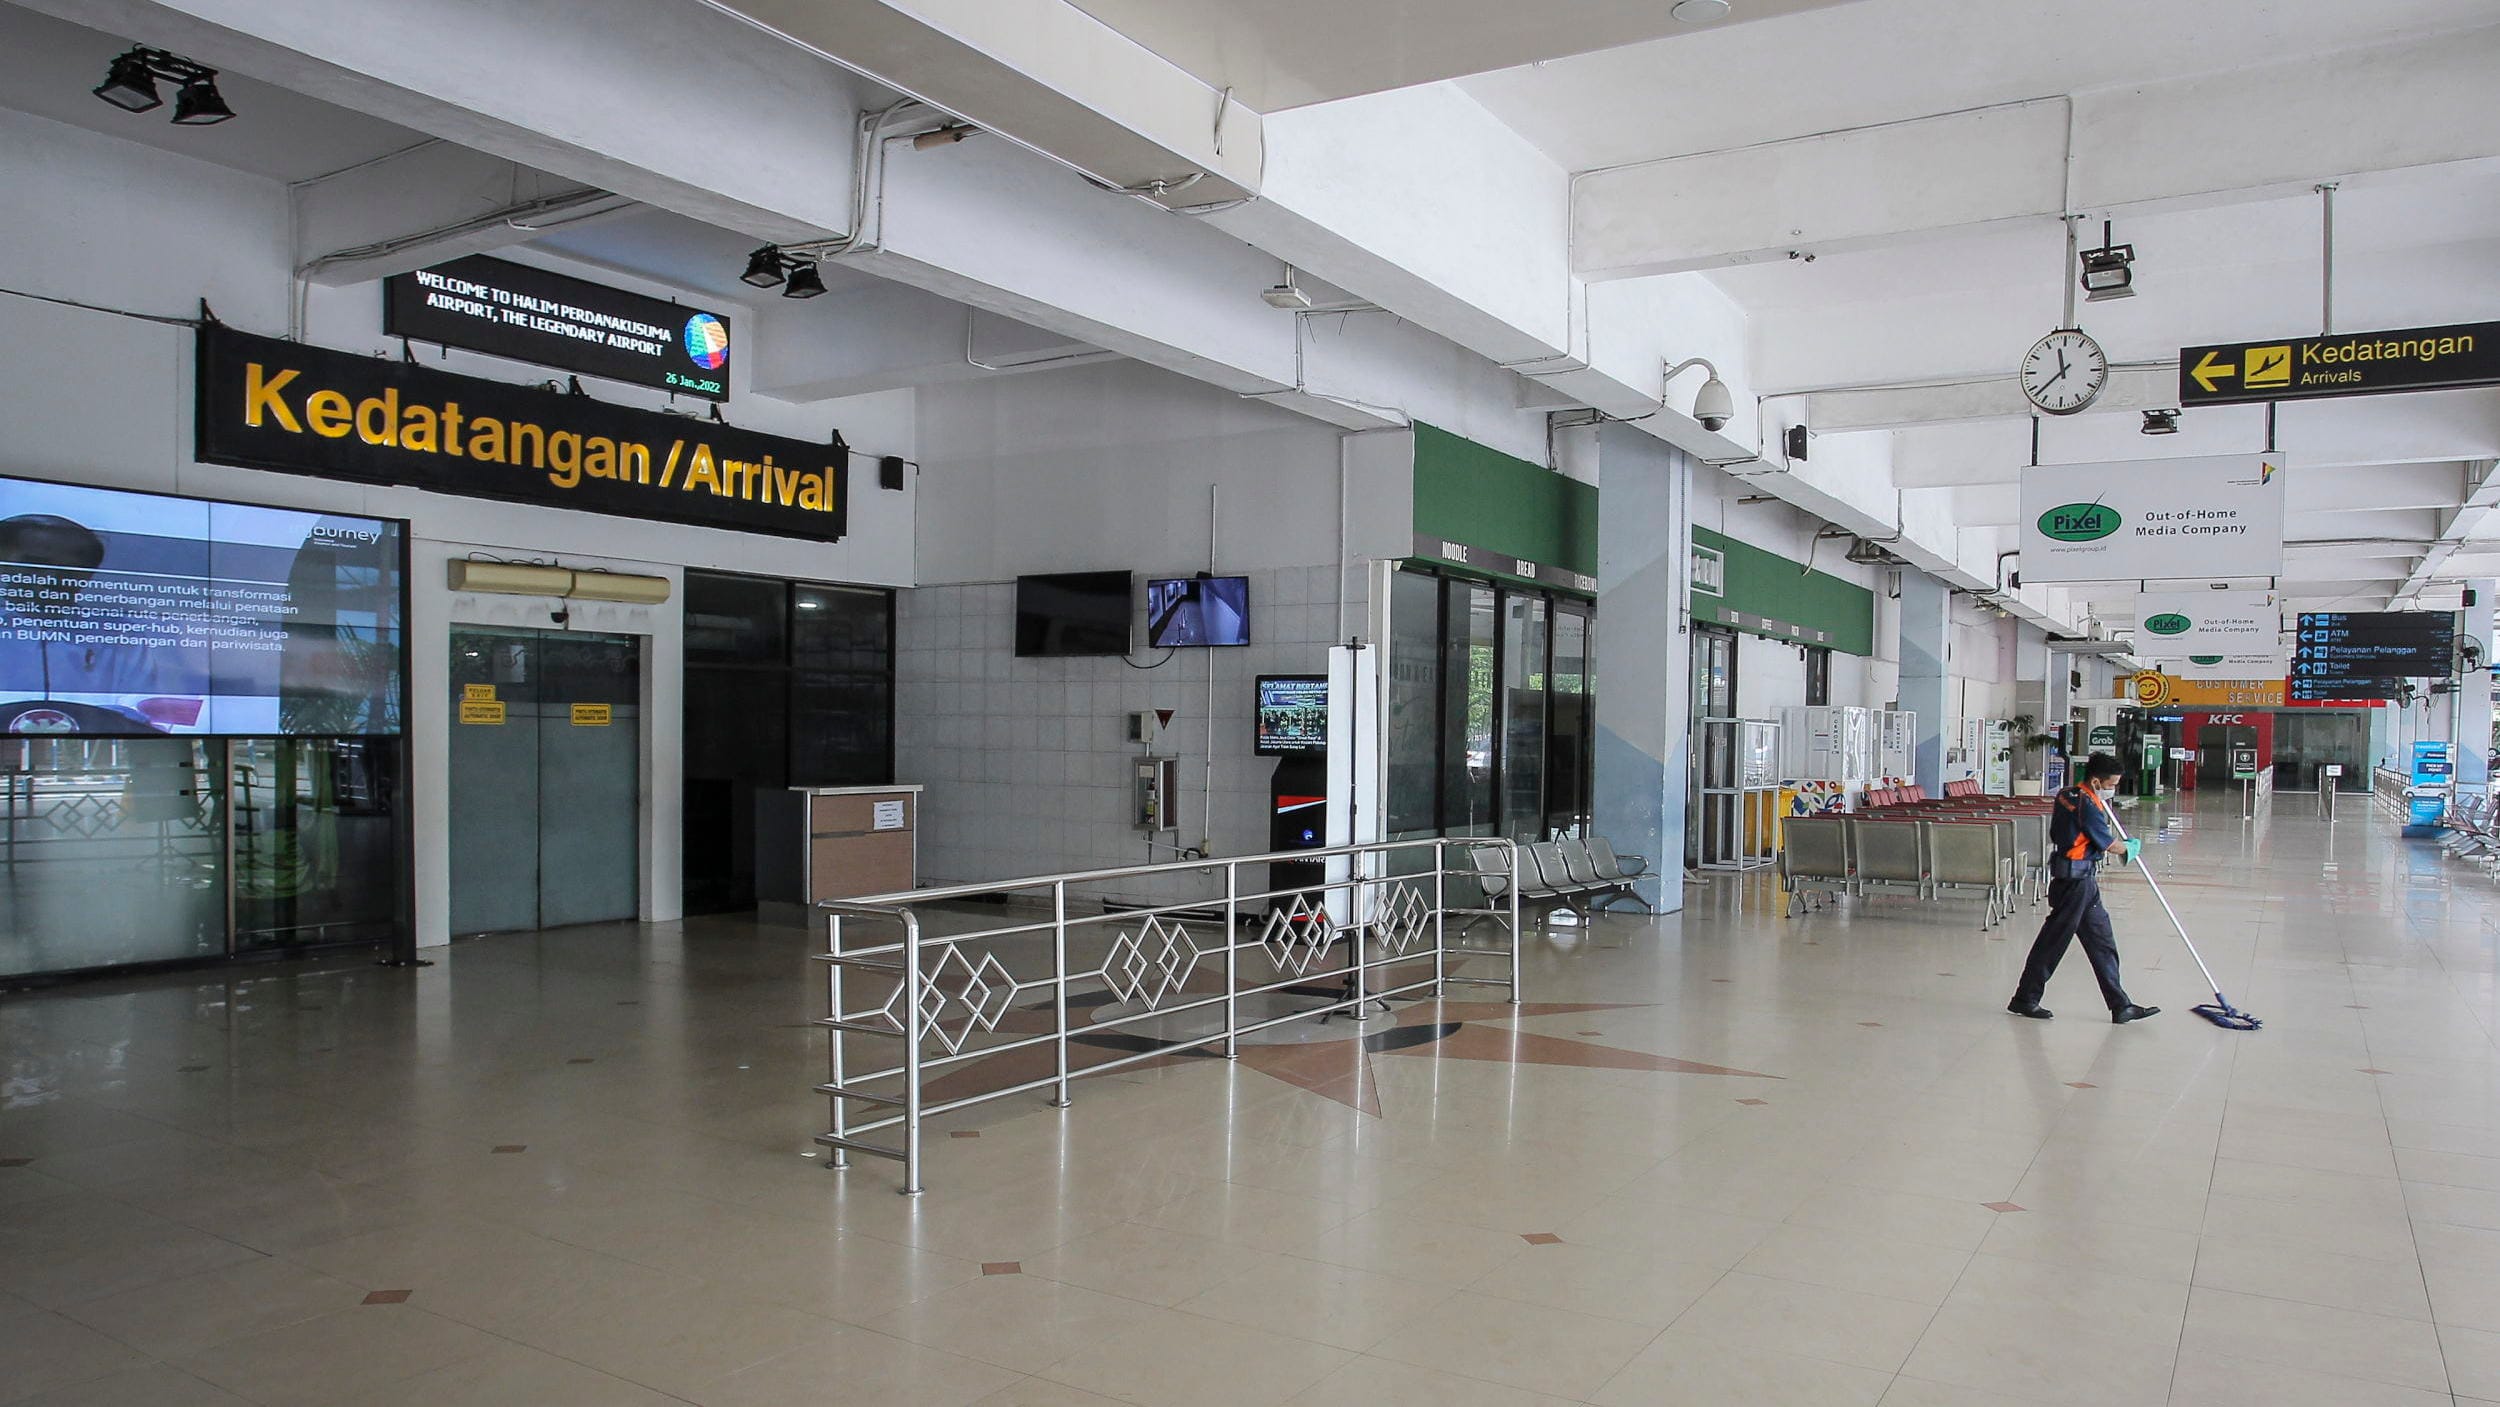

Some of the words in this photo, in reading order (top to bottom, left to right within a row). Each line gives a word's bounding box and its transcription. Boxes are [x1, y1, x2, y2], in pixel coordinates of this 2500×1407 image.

[416, 270, 489, 300] WELCOME
[490, 287, 511, 305] TO
[512, 293, 559, 316] HALIM
[560, 304, 672, 343] PERDANAKUSUMA
[426, 292, 498, 323] AIRPORT,
[501, 308, 529, 327] THE
[529, 315, 605, 344] LEGENDARY
[607, 333, 663, 357] AIRPORT
[2302, 335, 2473, 366] Kedatangan
[665, 372, 678, 385] 26
[2301, 369, 2362, 385] Arrivals
[245, 362, 651, 489] Kedatangan
[682, 442, 834, 513] Arrival
[2054, 505, 2101, 532] Pixel
[2145, 508, 2237, 521] Out-of-Home
[2135, 525, 2177, 536] Media
[2182, 525, 2247, 537] Company
[1442, 540, 1468, 563] NOODLE
[1516, 559, 1536, 579] BREAD
[0, 573, 57, 586] adalah
[61, 577, 154, 593] momentum
[157, 584, 199, 597] untuk
[203, 587, 291, 602] transformasi
[39, 589, 69, 600] dan
[74, 591, 175, 608] penerbangan
[179, 599, 231, 611] melalui
[235, 602, 298, 615] penataan
[5, 600, 41, 613] baik
[44, 604, 123, 619] mengenai
[128, 609, 158, 620] rute
[161, 611, 259, 626] penerbangan,
[2153, 615, 2180, 628] Pixel
[12, 616, 99, 630] penentuan
[103, 620, 183, 636] super-hub,
[187, 625, 256, 638] kemudian
[259, 630, 288, 641] juga
[17, 629, 71, 642] BUMN
[75, 633, 176, 649] penerbangan
[180, 638, 207, 649] dan
[212, 639, 286, 652] pariwisata.
[2330, 646, 2372, 654] Pelayanan
[2373, 646, 2416, 655] Pelanggan
[2330, 662, 2350, 670] Toilet
[2196, 680, 2264, 689] CUSTOMER
[2228, 692, 2283, 704] SERVICE
[2208, 714, 2243, 724] KFC
[2091, 736, 2114, 745] Grab
